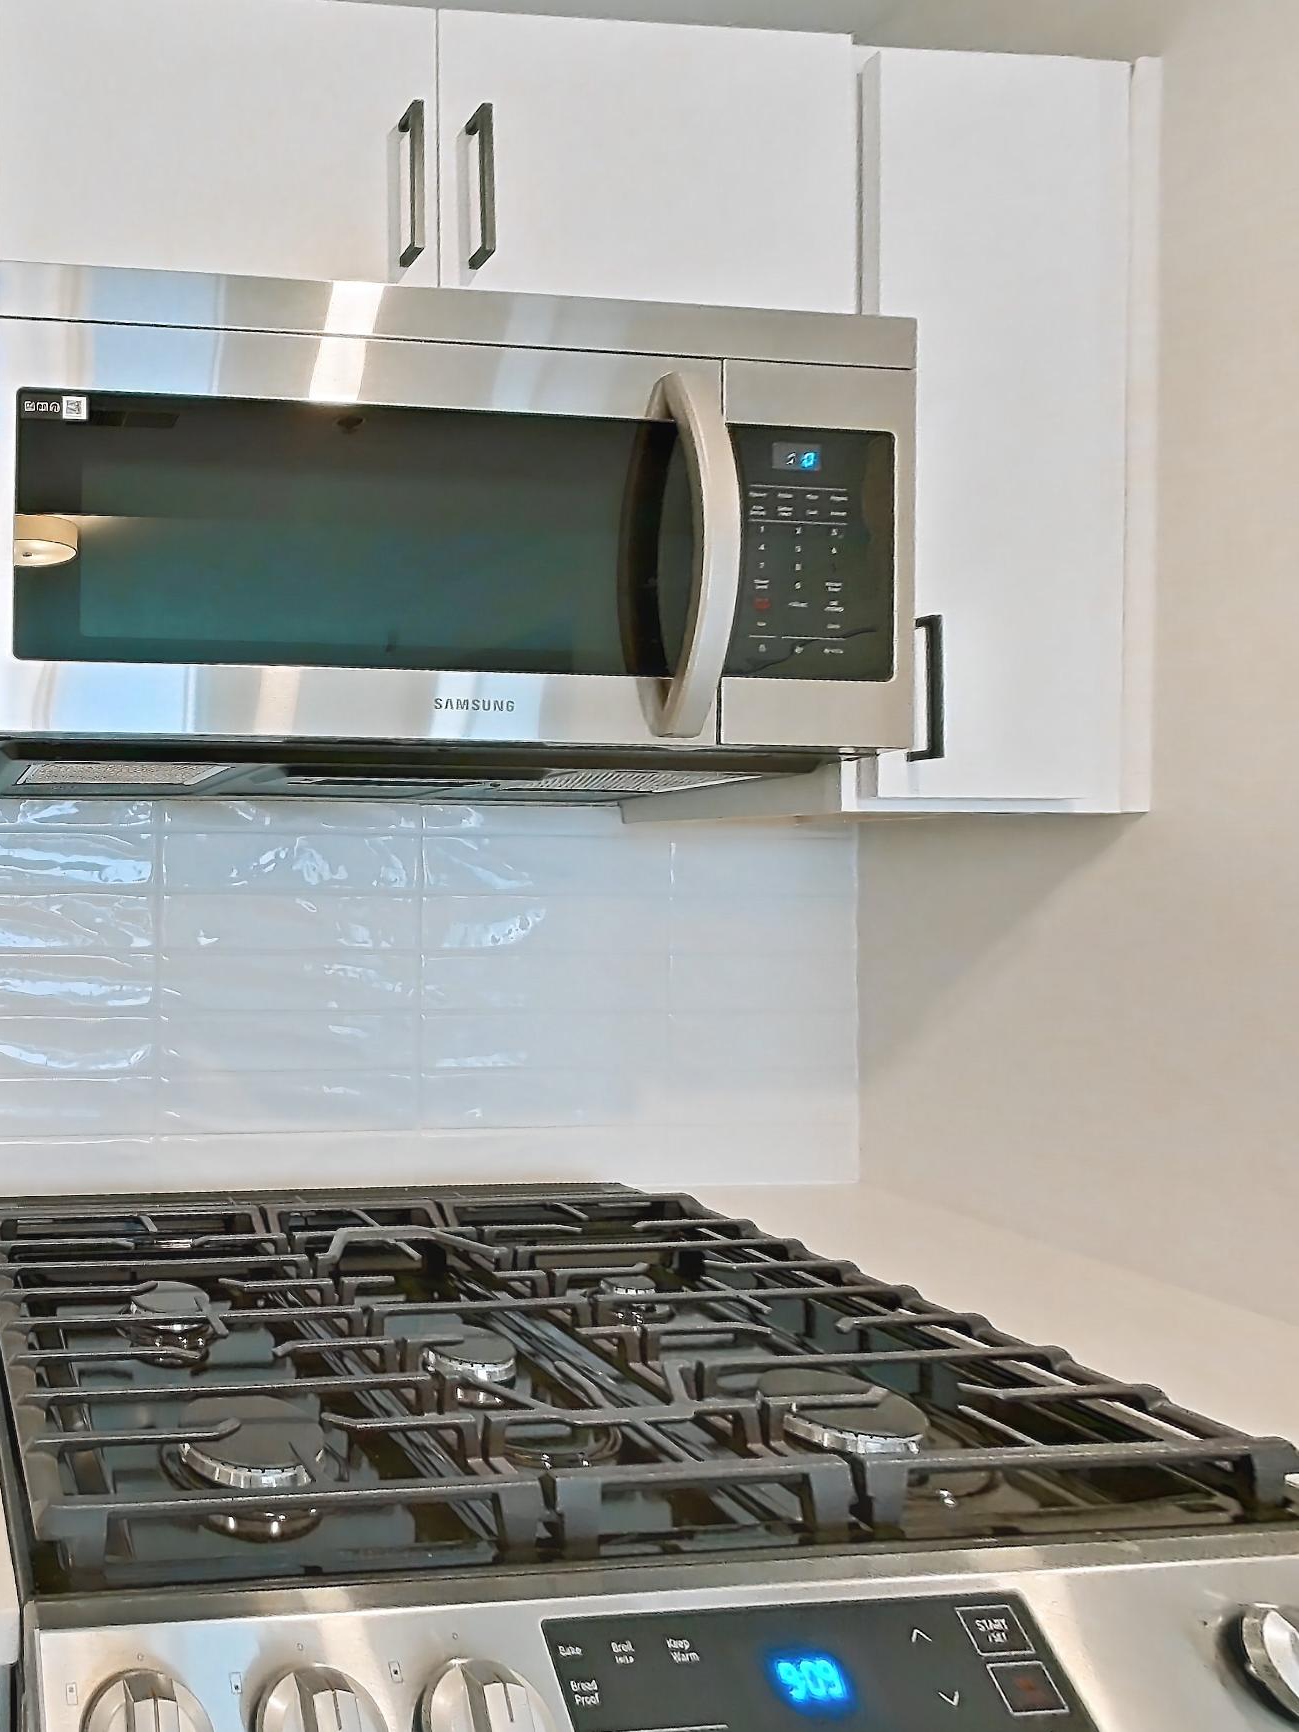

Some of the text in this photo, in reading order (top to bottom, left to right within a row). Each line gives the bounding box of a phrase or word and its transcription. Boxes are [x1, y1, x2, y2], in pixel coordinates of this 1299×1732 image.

[433, 697, 515, 712] SAMSUNG
[611, 1640, 635, 1653] Broil
[666, 1638, 690, 1650] Keep
[671, 1651, 700, 1663] Warm
[570, 1680, 599, 1692] Bread
[575, 1692, 600, 1706] Proof
